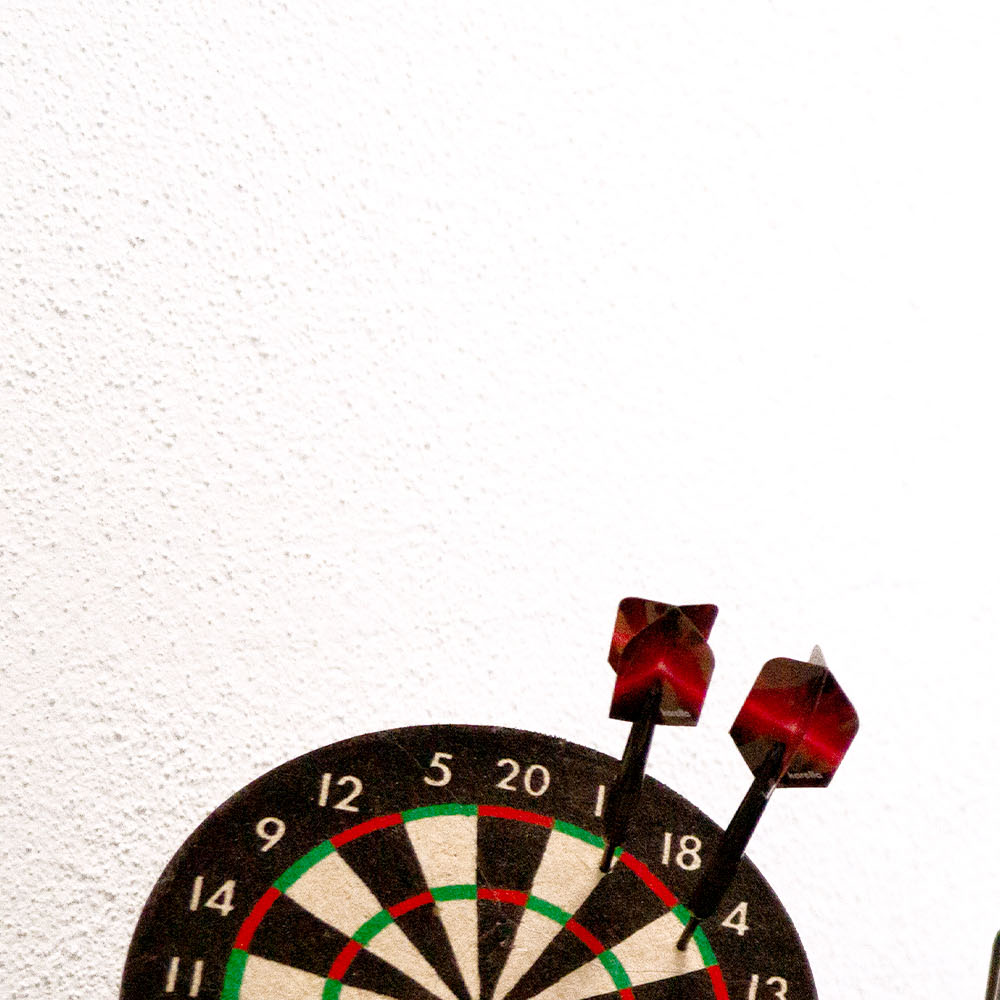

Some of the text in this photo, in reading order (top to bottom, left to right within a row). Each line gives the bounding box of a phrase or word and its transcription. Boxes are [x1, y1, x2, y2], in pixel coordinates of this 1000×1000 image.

[424, 753, 452, 786] 5
[497, 759, 550, 796] 20
[319, 773, 362, 811] 12
[257, 818, 285, 851] 9
[662, 833, 701, 870] 18
[190, 876, 235, 916] 14
[722, 902, 748, 935] 4
[166, 957, 203, 996] 11
